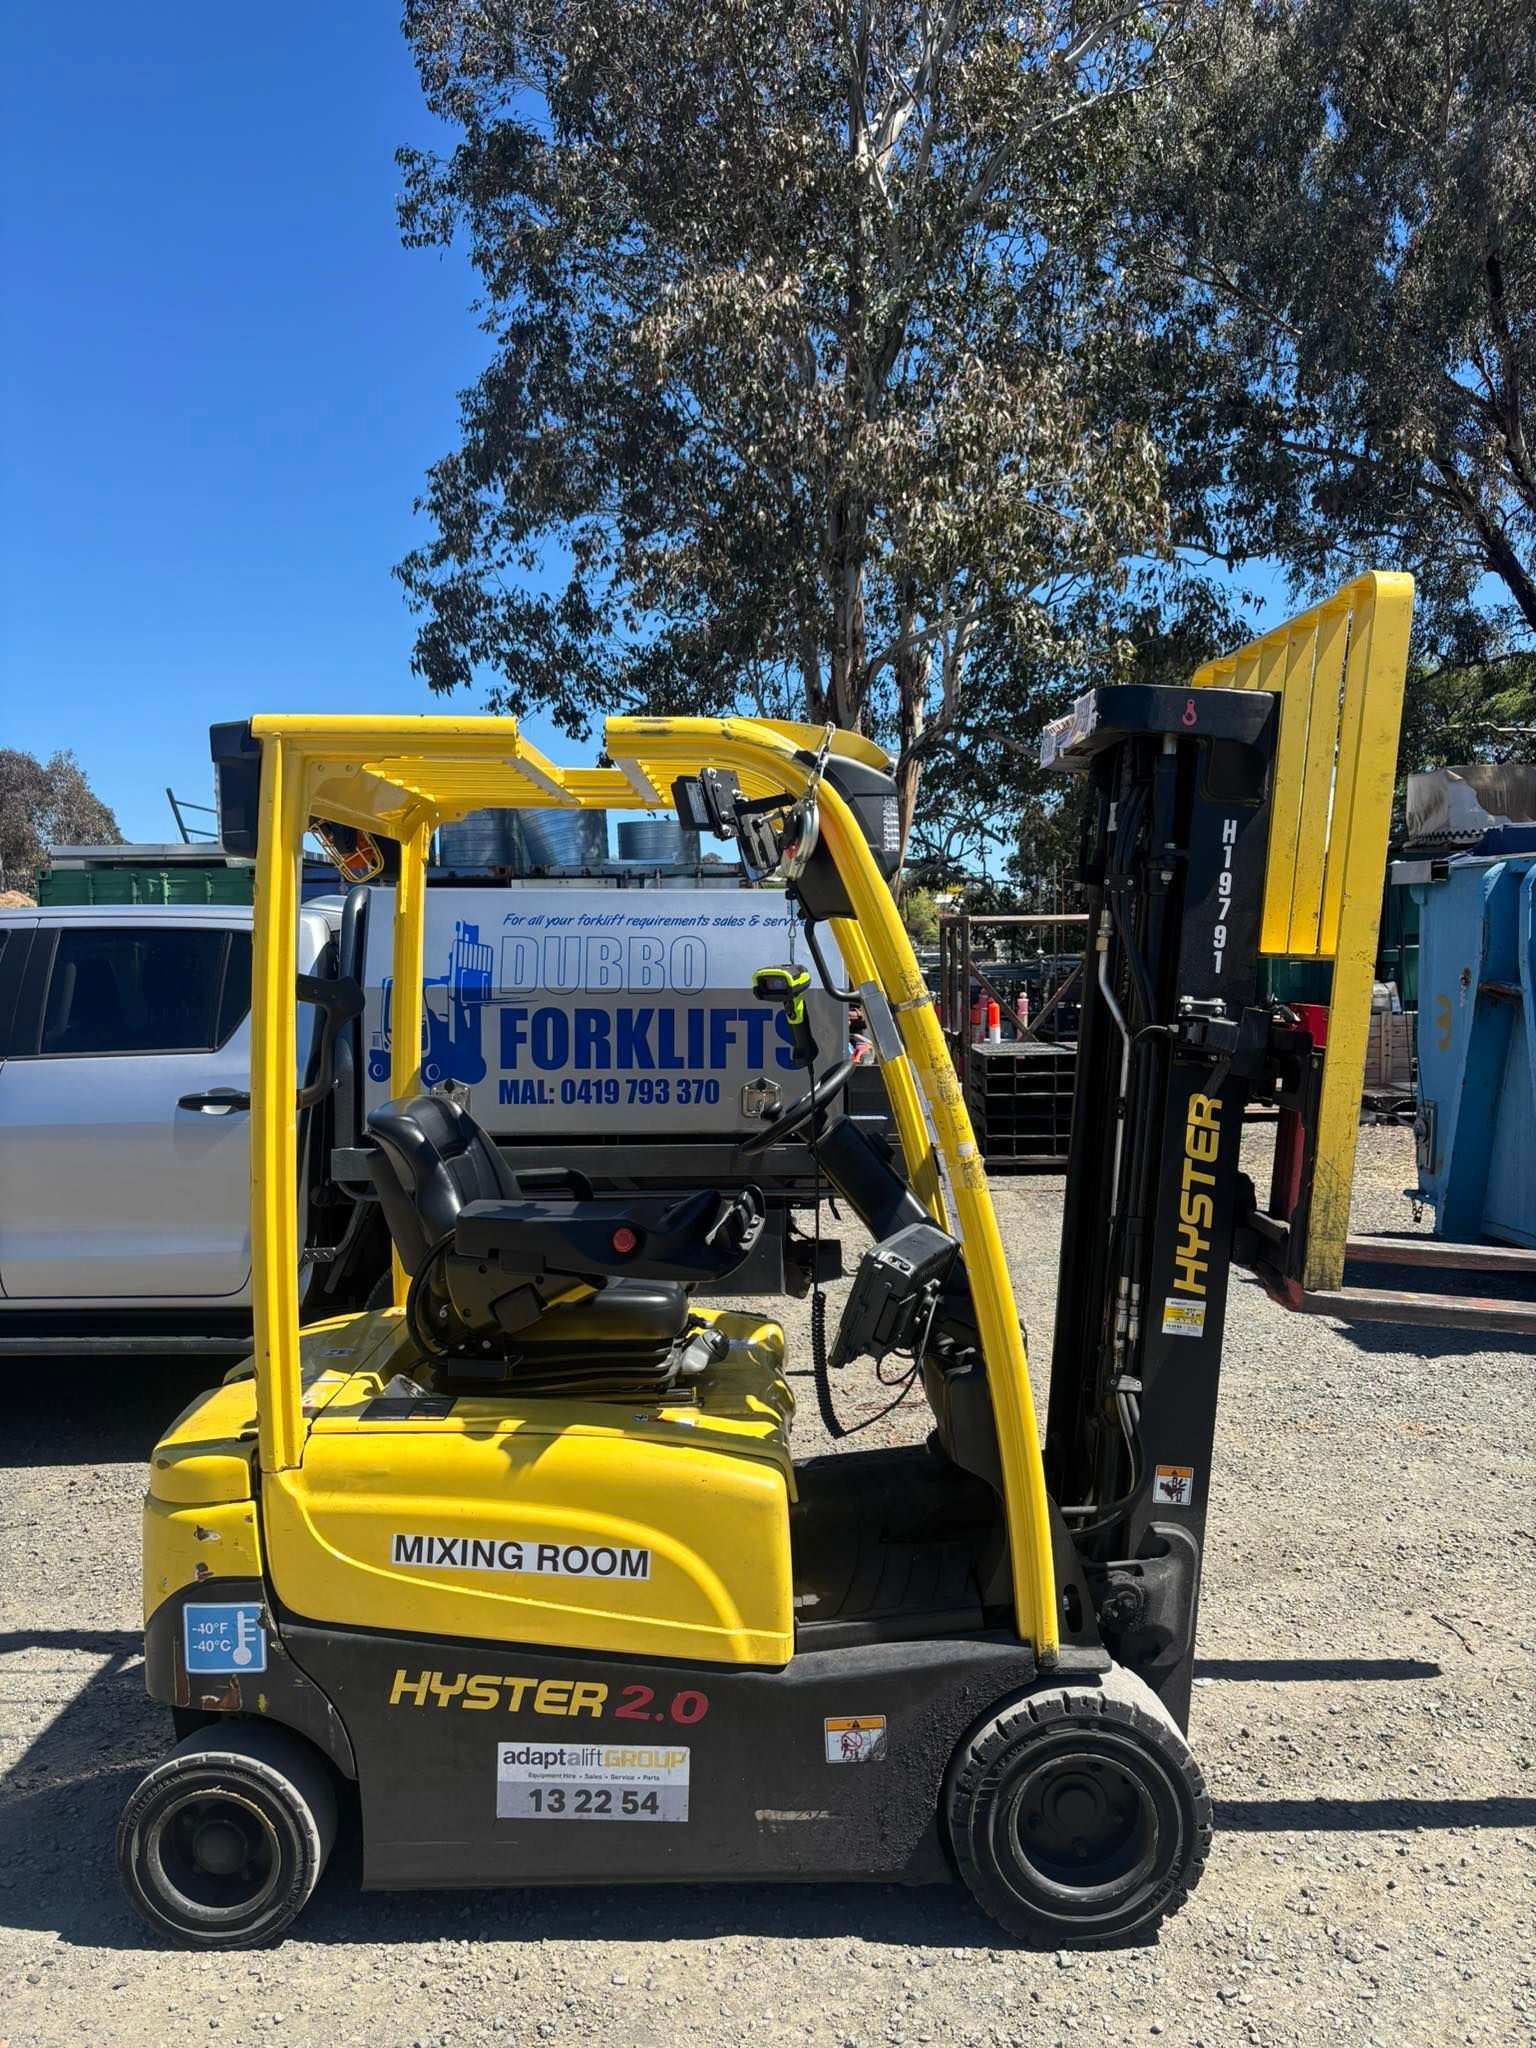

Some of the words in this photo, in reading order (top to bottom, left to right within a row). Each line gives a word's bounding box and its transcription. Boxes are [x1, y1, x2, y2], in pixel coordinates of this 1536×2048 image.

[1213, 819, 1238, 974] H19791
[503, 913, 526, 925] For
[528, 914, 546, 926] all
[545, 917, 575, 929] your
[578, 913, 625, 926] forklift
[626, 914, 710, 929] requirements
[712, 914, 746, 926] sales
[749, 914, 760, 926] &
[500, 936, 707, 995] DUBBO
[499, 1079, 555, 1104] MAL:
[561, 1078, 620, 1104] 0419
[625, 1078, 670, 1104] 793
[676, 1078, 720, 1104] 370
[1173, 1093, 1223, 1296] HYSTER
[394, 1535, 524, 1570] MIXING
[537, 1544, 649, 1578] ROOM
[193, 1640, 231, 1652] -40°C
[389, 1669, 609, 1718] HYSTER
[615, 1685, 709, 1724] 2.0
[529, 1789, 566, 1813] 13
[574, 1790, 612, 1813] 22
[621, 1791, 659, 1815] 54
